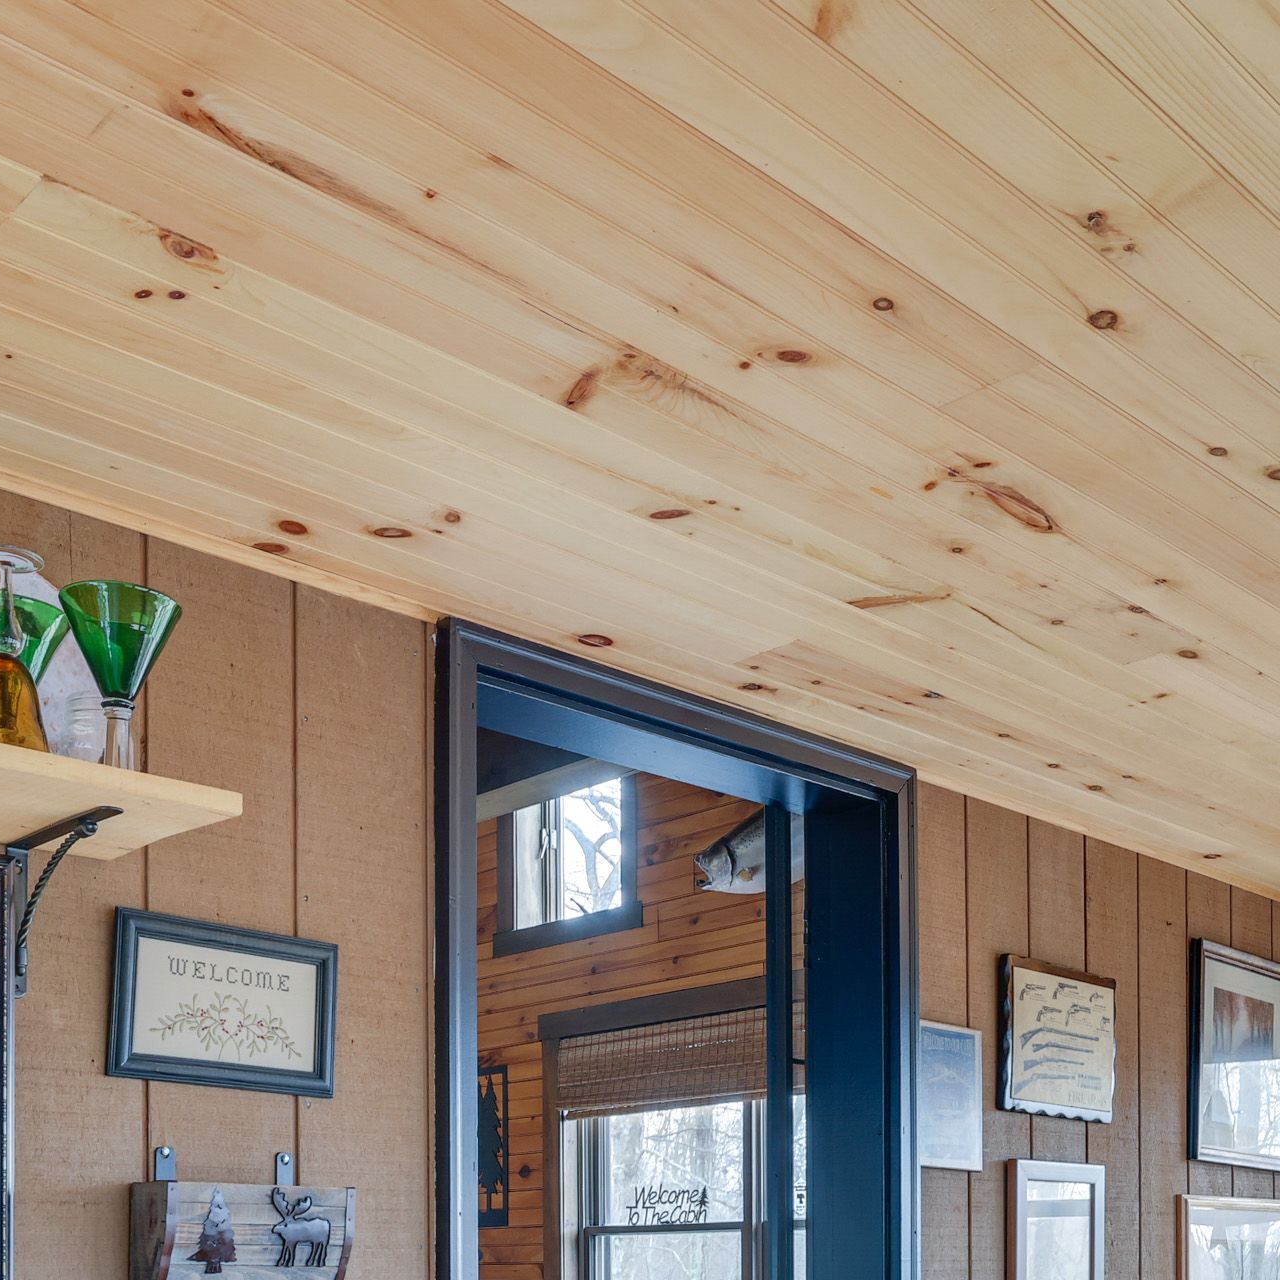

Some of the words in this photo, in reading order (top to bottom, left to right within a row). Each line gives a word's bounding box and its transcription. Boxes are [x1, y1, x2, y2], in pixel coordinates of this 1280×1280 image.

[167, 954, 291, 993] WELCOME
[634, 1184, 699, 1207] Welcome
[626, 1206, 640, 1225] To
[641, 1206, 669, 1225] The
[670, 1204, 708, 1225] Cabin
